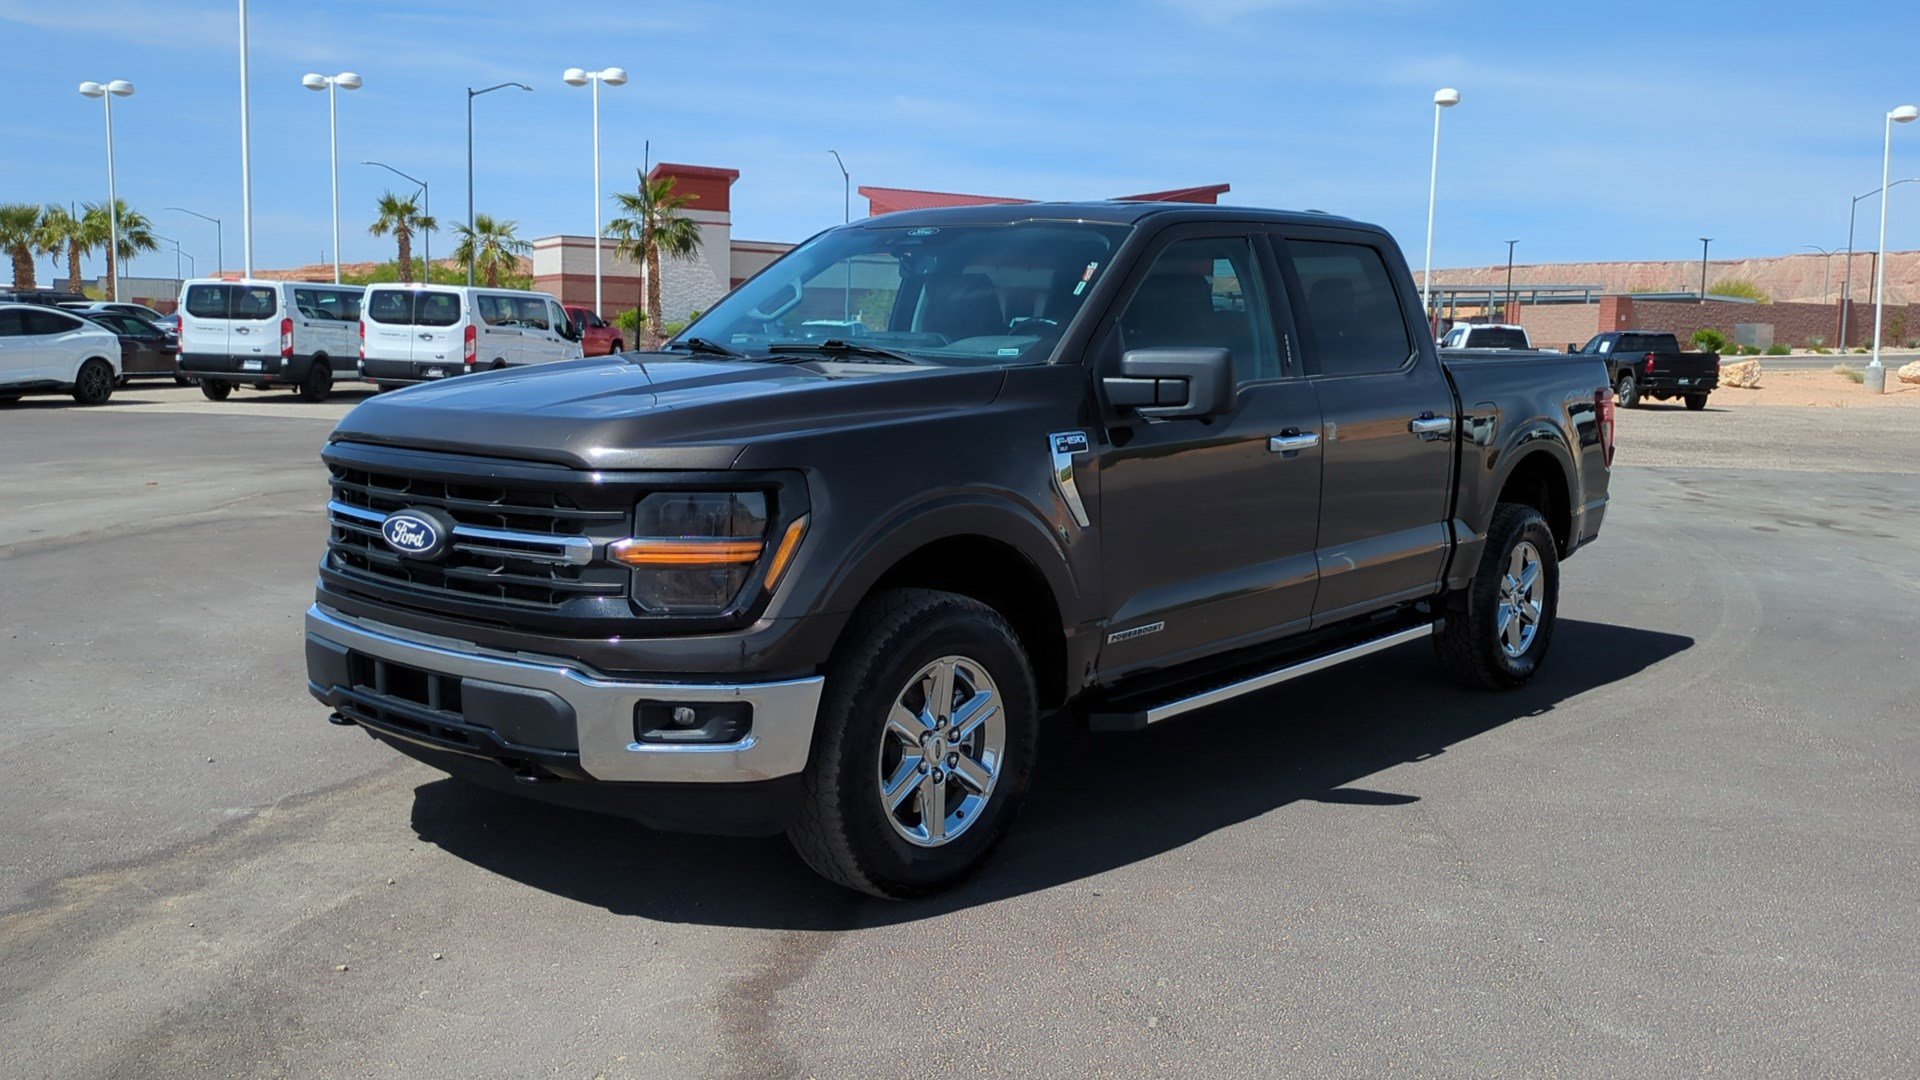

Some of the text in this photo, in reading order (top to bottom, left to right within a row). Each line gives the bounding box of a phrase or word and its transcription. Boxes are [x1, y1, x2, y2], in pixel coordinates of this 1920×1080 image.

[1056, 435, 1086, 445] F-150
[392, 520, 425, 547] Ford
[1111, 624, 1162, 641] POWERBOOST
